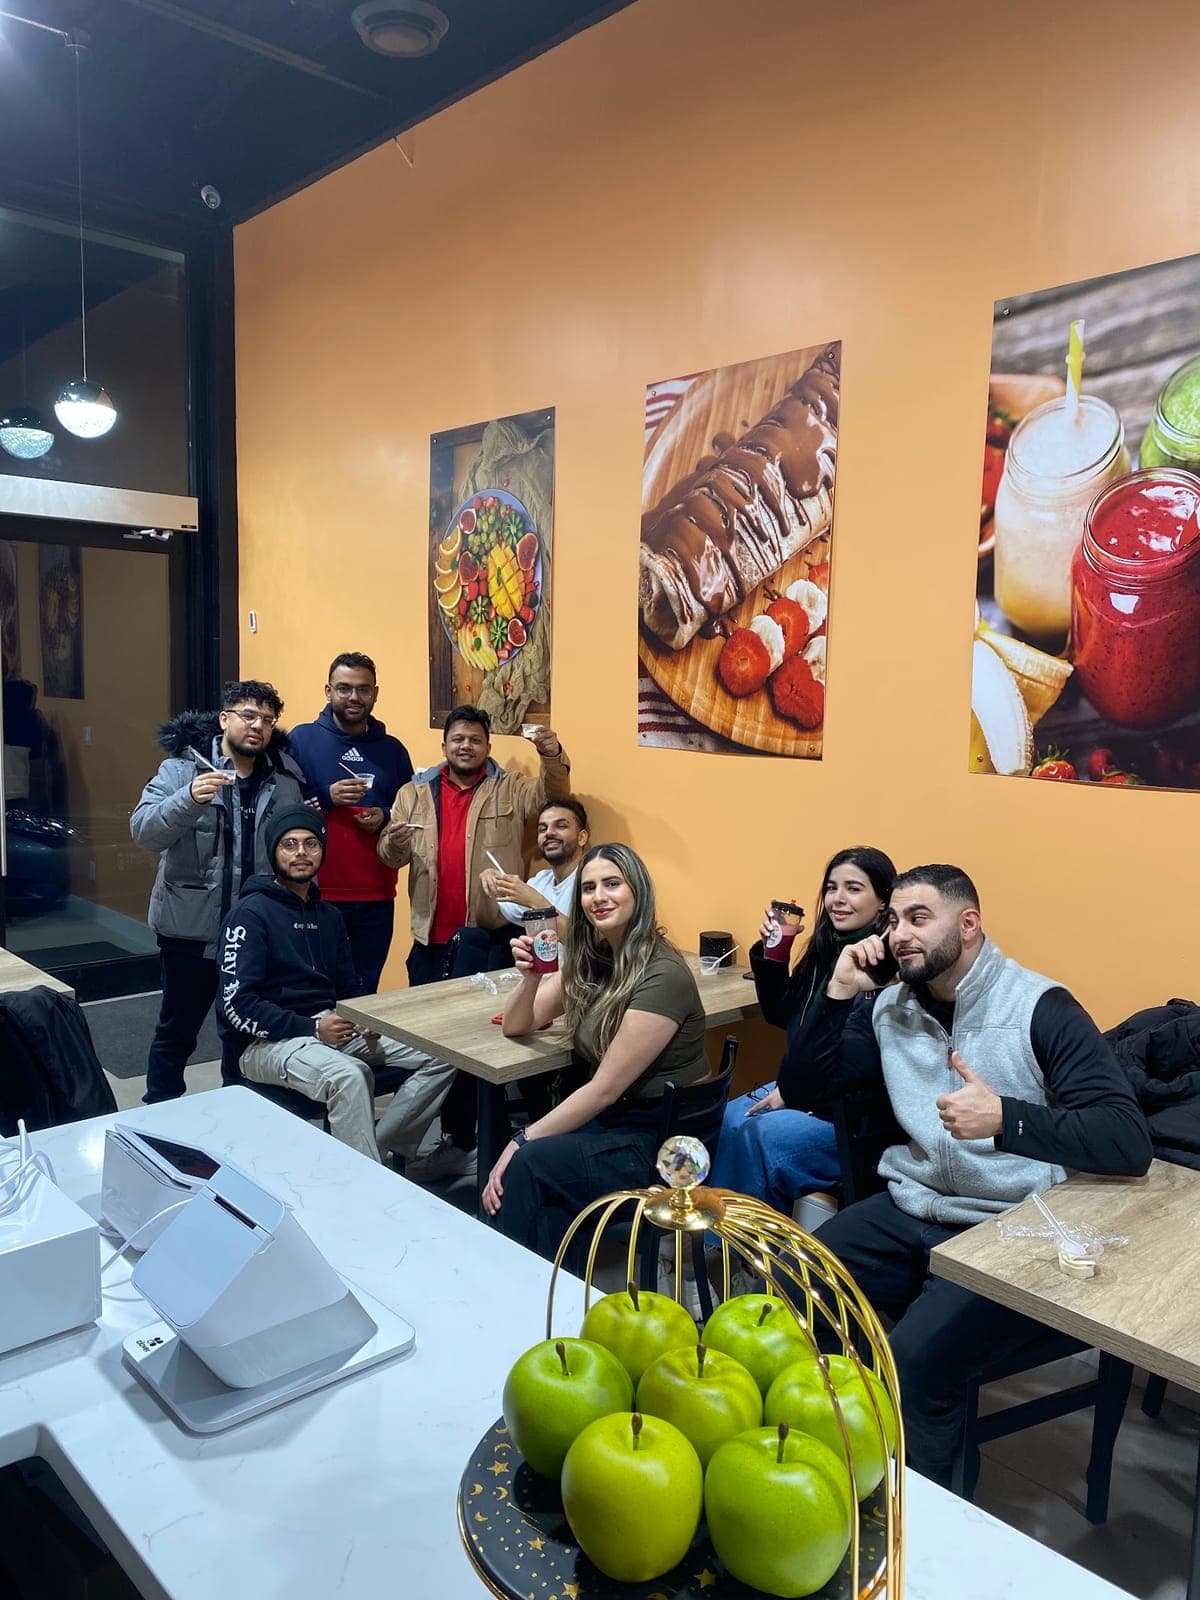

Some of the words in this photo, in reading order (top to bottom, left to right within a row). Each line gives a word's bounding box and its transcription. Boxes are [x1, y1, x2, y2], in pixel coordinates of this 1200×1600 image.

[221, 925, 247, 975] Stay
[222, 979, 270, 1038] Humble
[136, 1339, 151, 1353] clover
